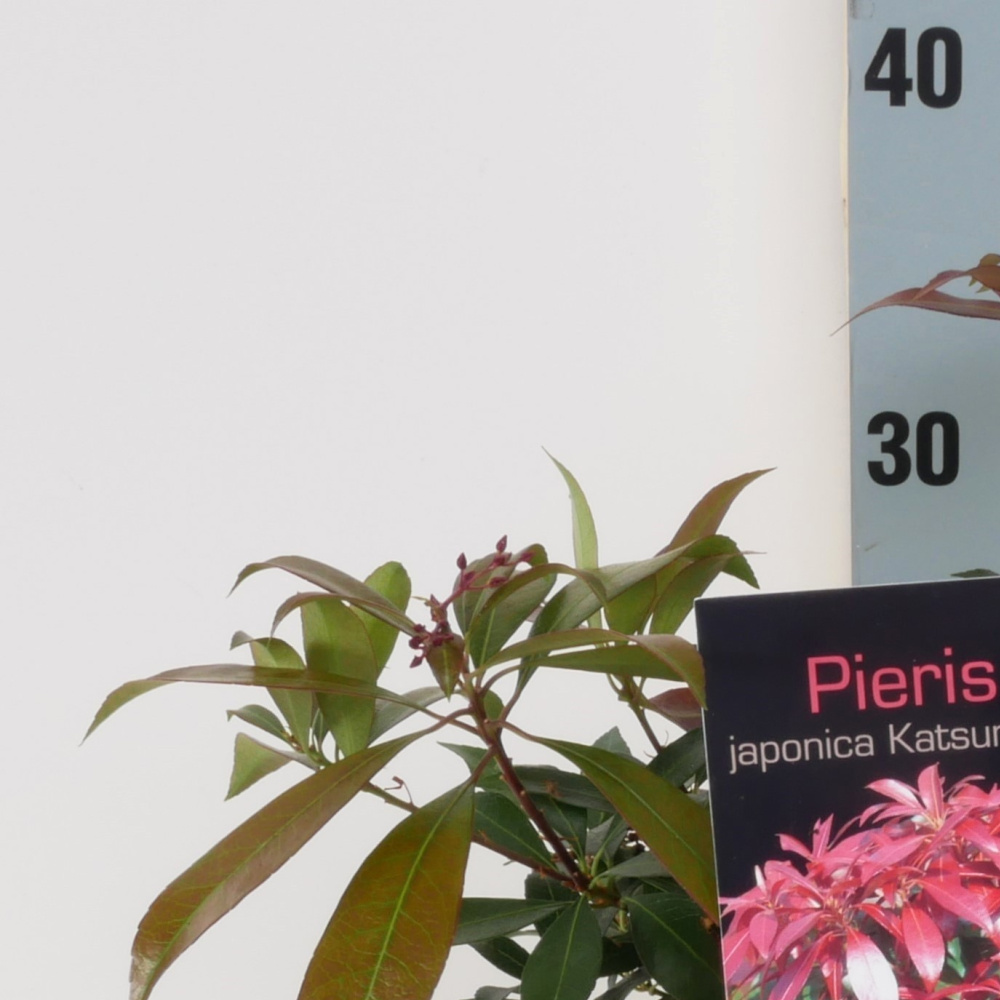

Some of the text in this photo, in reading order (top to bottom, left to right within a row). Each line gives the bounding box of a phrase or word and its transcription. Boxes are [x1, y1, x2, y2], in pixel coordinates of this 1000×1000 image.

[864, 27, 963, 109] 40
[867, 410, 960, 487] 30
[806, 646, 998, 714] Pieris
[728, 728, 875, 775] japonica
